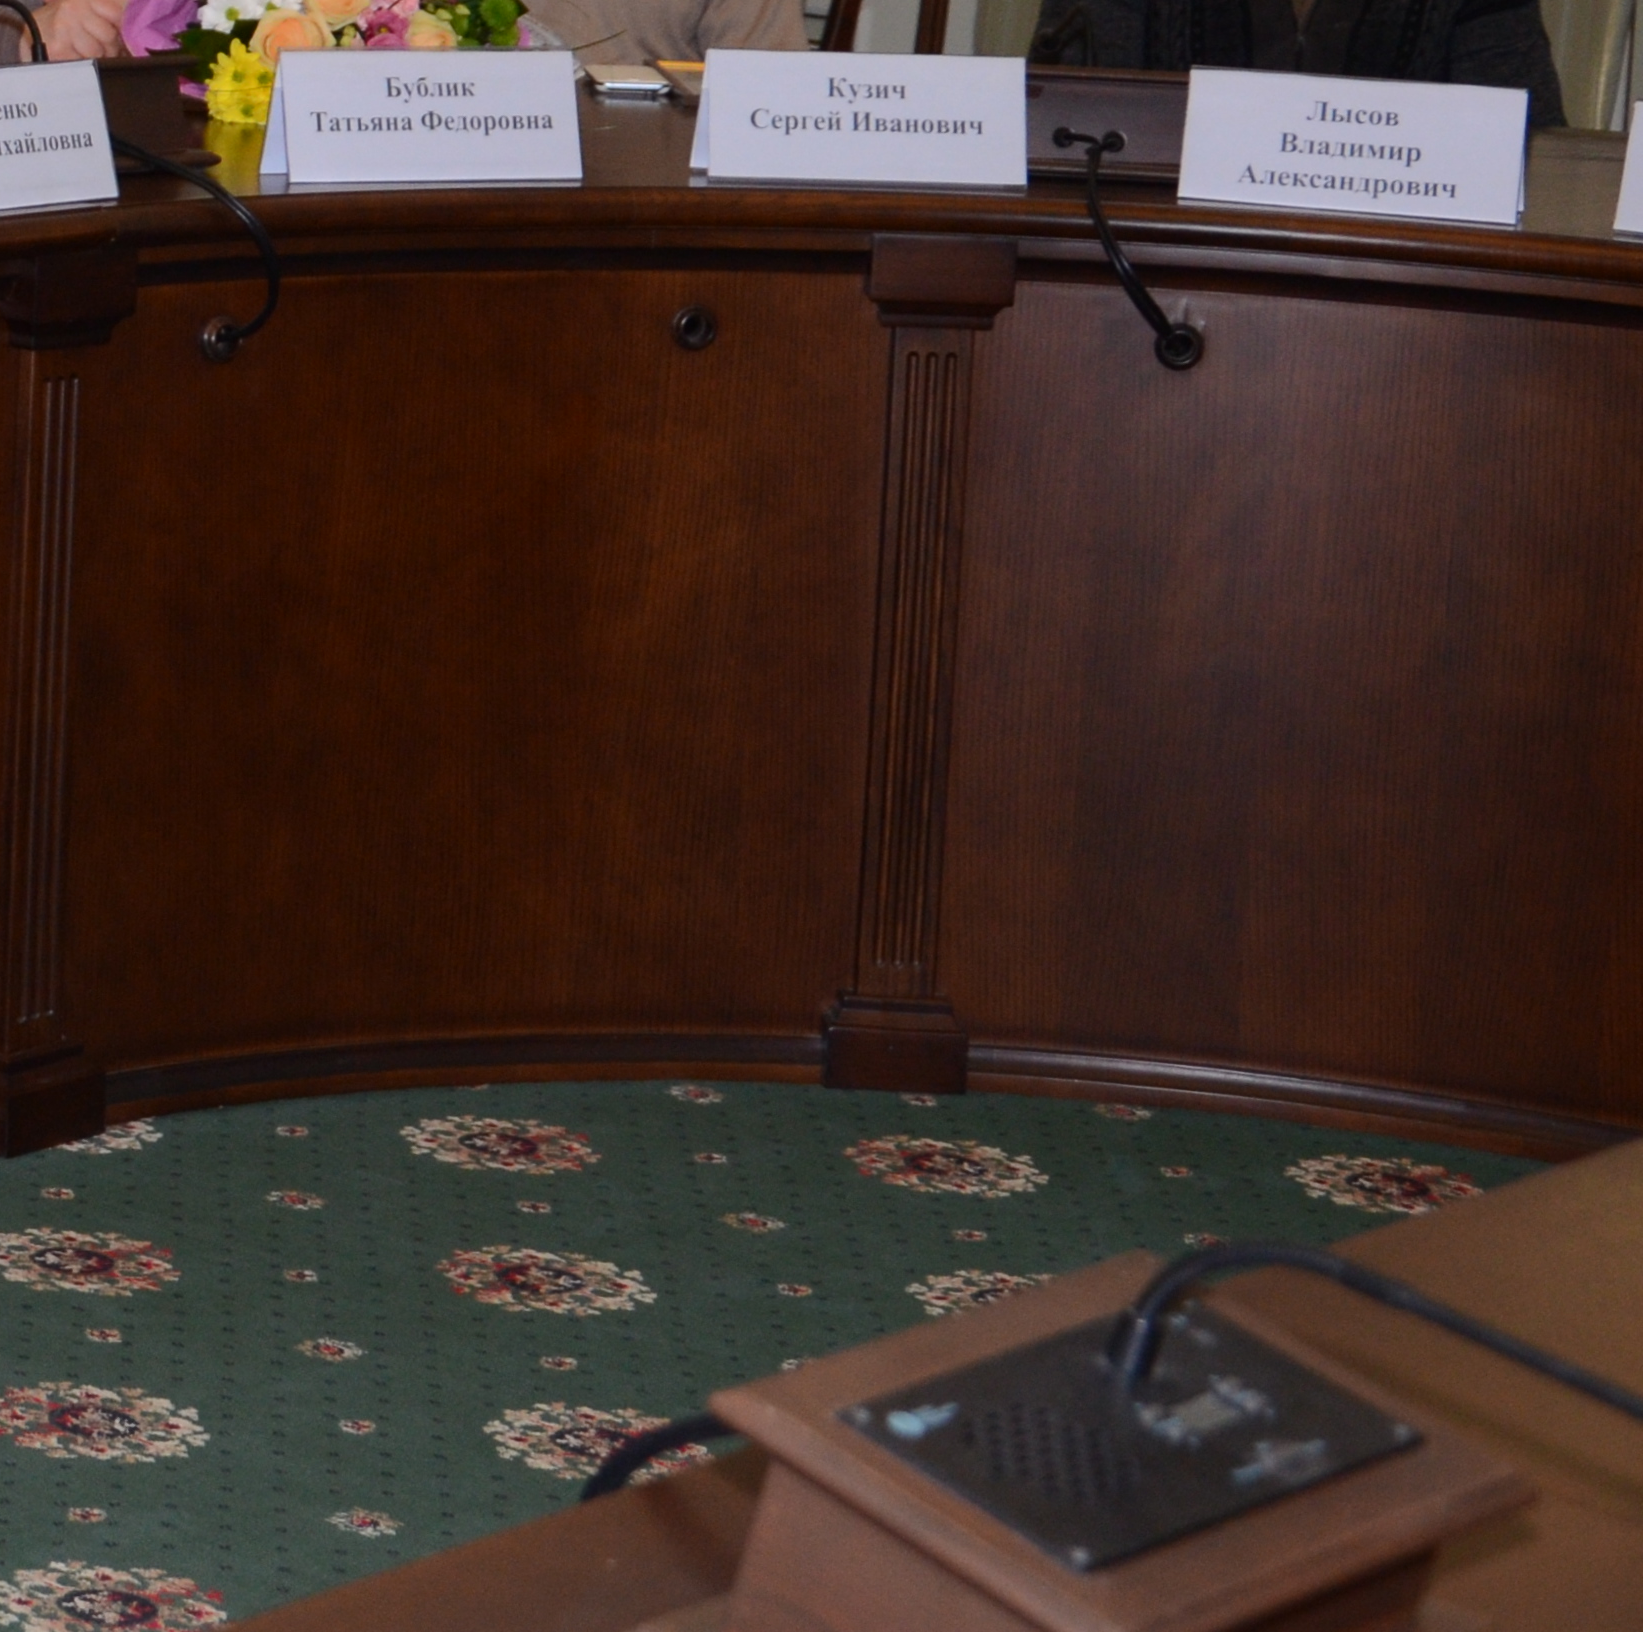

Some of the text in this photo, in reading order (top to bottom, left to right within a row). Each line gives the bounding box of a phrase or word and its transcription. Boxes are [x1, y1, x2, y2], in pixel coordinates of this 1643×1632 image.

[385, 76, 475, 103] Бублик
[827, 77, 907, 104] Кузич
[310, 110, 554, 136] Татьяна Федоровна
[750, 108, 984, 136] Сергей Иванович
[1306, 101, 1400, 128] Лысов
[1279, 132, 1422, 167] Владимир
[1237, 165, 1457, 199] Александрович
